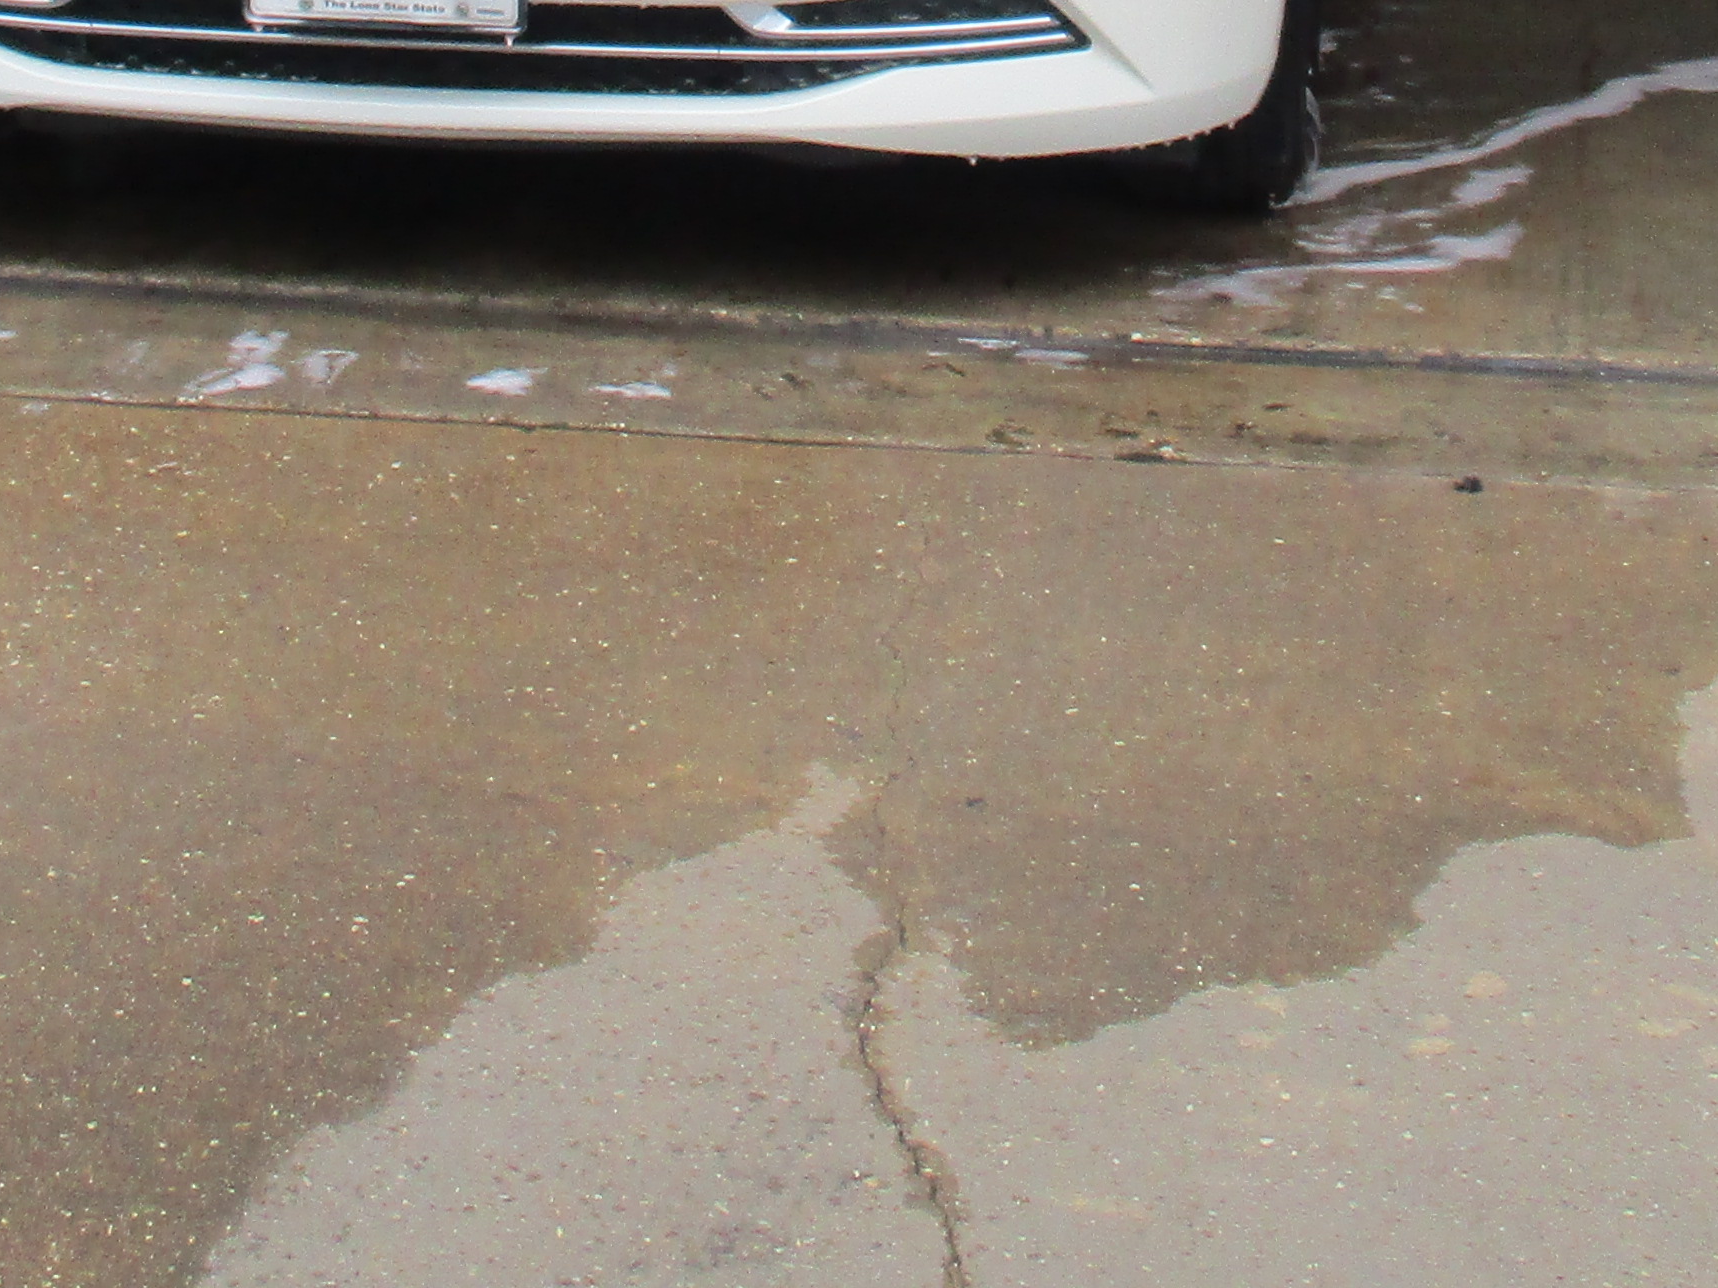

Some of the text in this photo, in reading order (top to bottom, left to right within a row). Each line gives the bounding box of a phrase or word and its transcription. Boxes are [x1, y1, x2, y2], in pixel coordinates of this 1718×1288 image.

[324, 0, 446, 14] The Lone Star State
